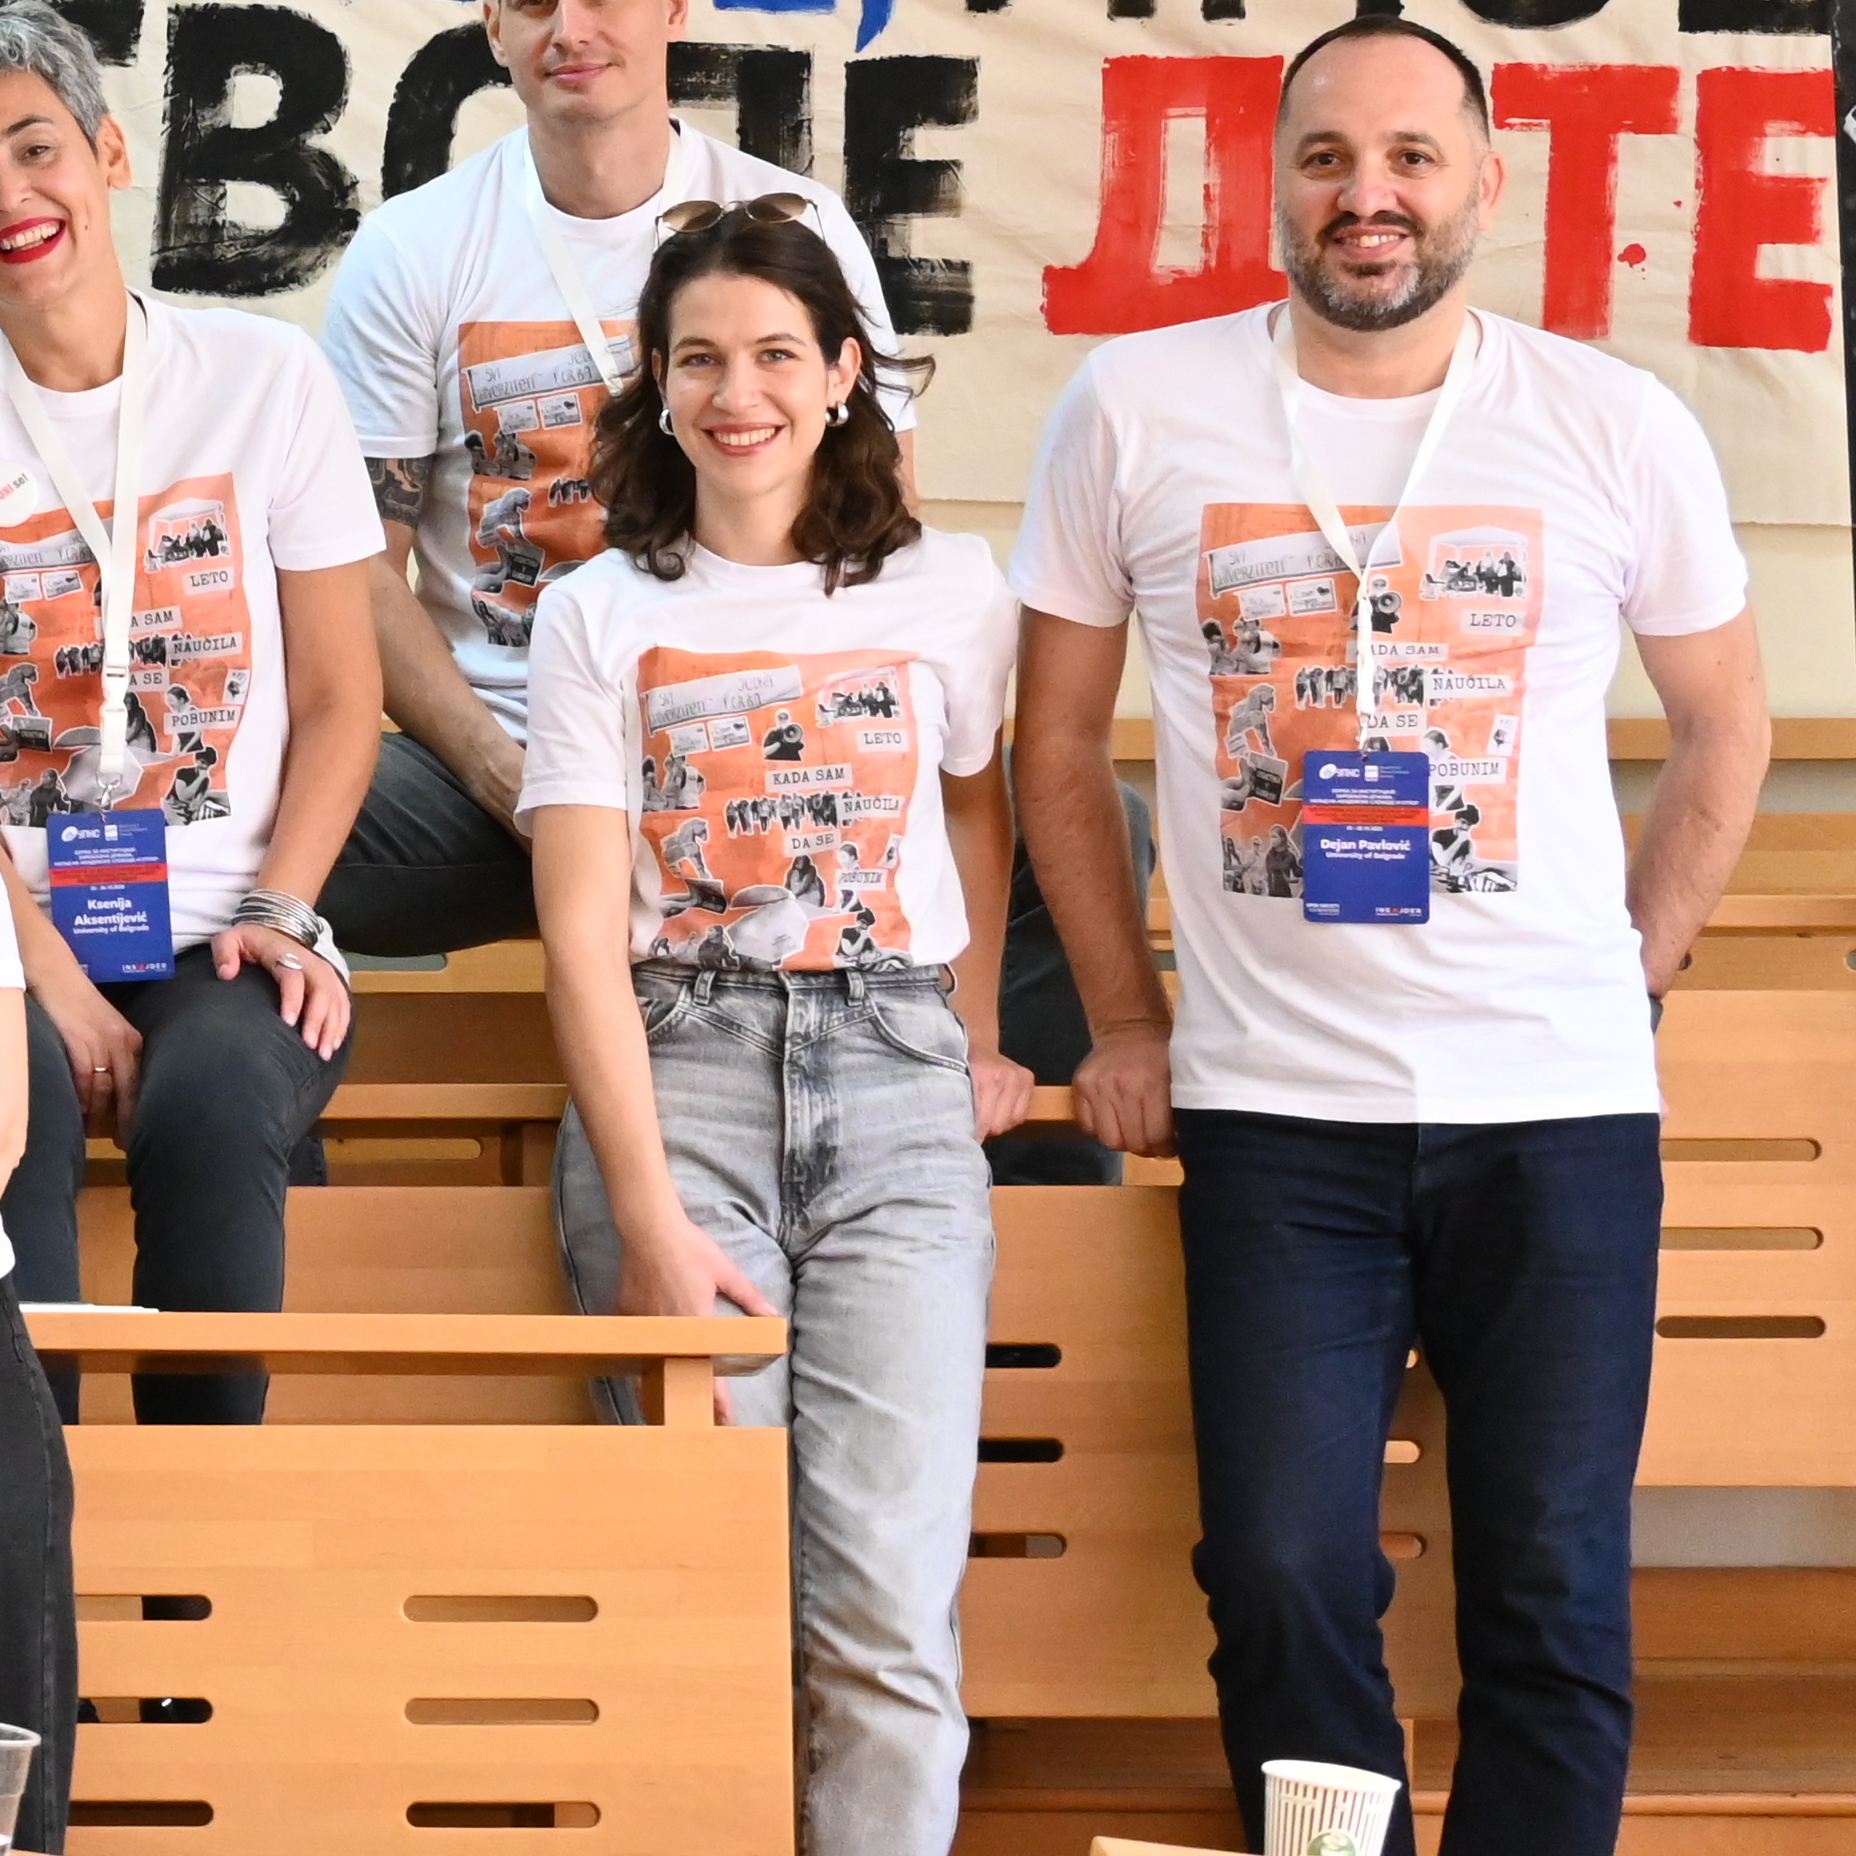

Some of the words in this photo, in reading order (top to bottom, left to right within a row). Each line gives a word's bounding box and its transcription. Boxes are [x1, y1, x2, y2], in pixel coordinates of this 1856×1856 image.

[1042, 54, 1835, 352] ДТЕ
[190, 570, 229, 587] LETO
[144, 610, 173, 625] SAM
[1470, 613, 1516, 627] LETO
[174, 636, 237, 655] NAUČILA
[1405, 645, 1440, 655] SAM
[143, 673, 163, 685] SE
[1433, 676, 1506, 691] NAUČILA
[172, 709, 236, 727] POBUNIM
[1367, 715, 1389, 729] DA
[1396, 714, 1418, 727] SE
[864, 732, 902, 745] LETO
[772, 771, 811, 785] KADA
[815, 767, 844, 781] SAM
[1428, 762, 1499, 777] POBUNIM
[792, 838, 811, 850] DA
[816, 833, 834, 845] SE
[1320, 839, 1357, 852] Dejan
[1358, 839, 1411, 851] Pavlović
[87, 898, 132, 910] Ksenija
[74, 911, 148, 927] Aksentijević
